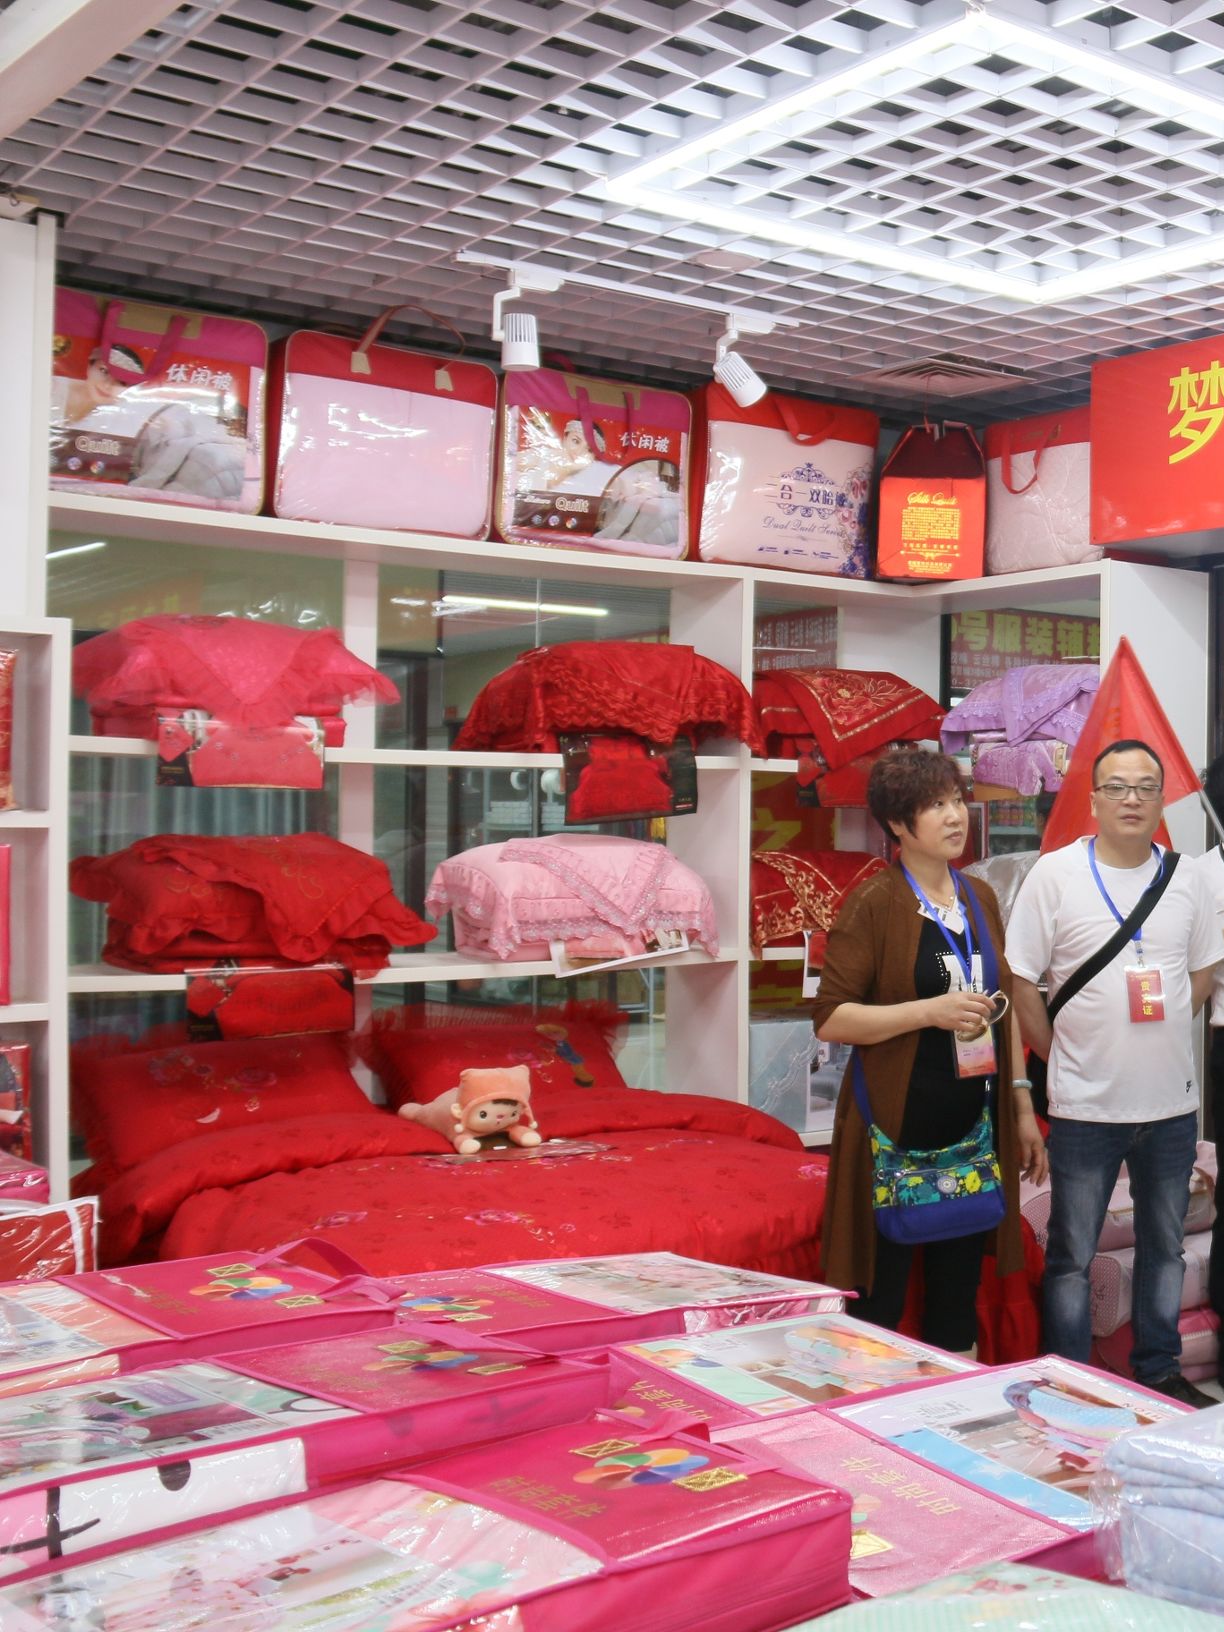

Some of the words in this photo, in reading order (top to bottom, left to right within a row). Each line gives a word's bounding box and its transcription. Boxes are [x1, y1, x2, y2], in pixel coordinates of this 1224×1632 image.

[166, 363, 233, 391] 休闲被
[75, 435, 121, 456] Quilt
[620, 431, 670, 453] 休闲被
[555, 496, 589, 513] Quilt
[840, 1456, 962, 1516] 时尚套件
